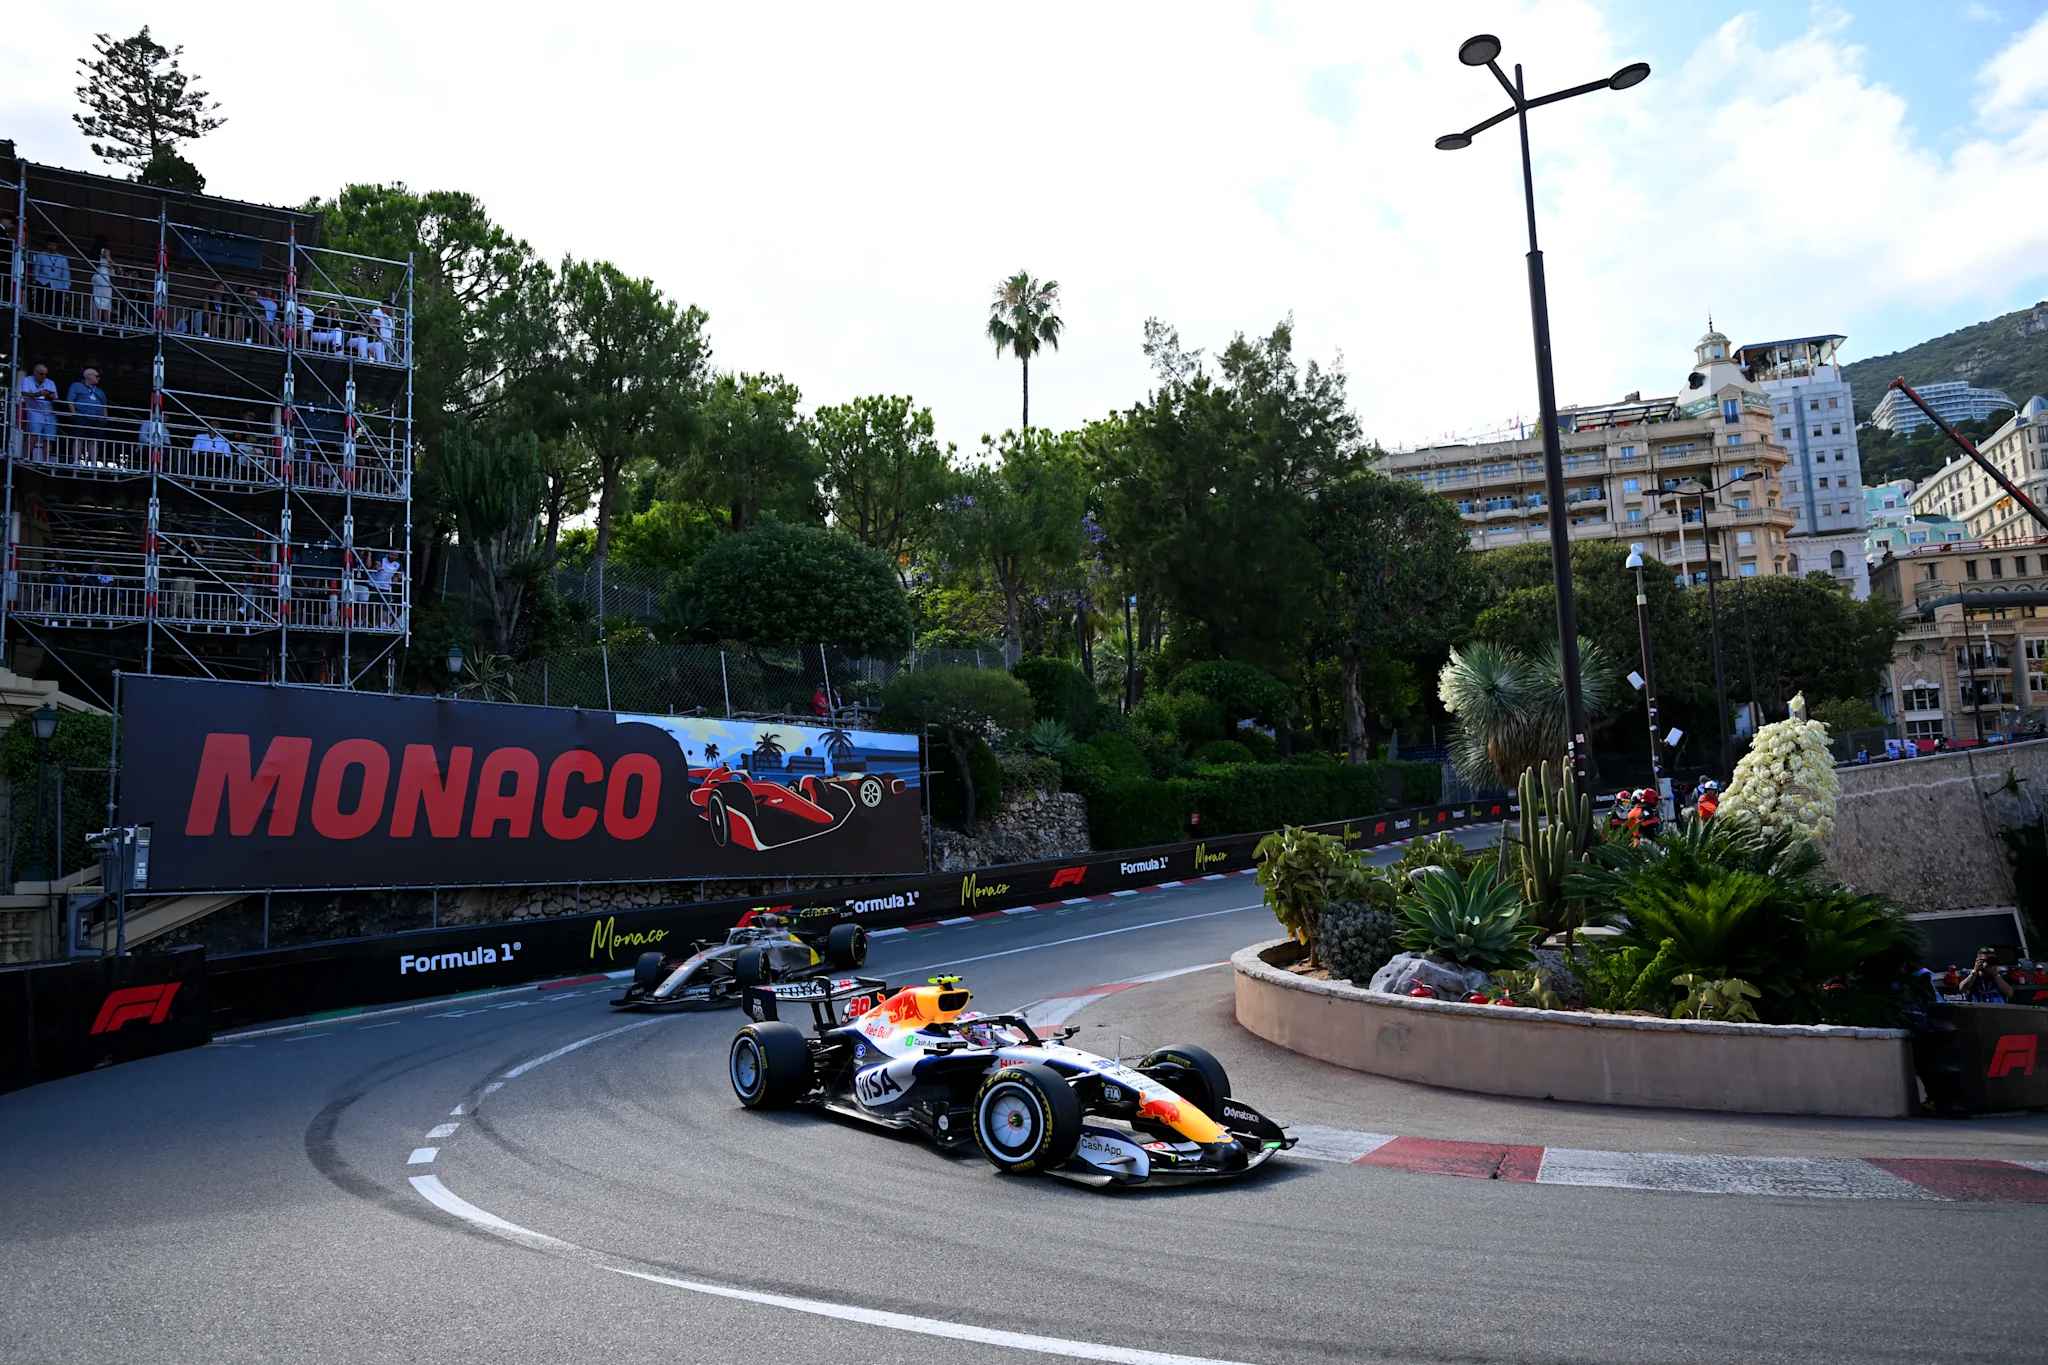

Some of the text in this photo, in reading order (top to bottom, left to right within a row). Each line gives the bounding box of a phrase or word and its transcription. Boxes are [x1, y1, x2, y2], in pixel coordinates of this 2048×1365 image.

[186, 733, 662, 841] MONACO
[1120, 859, 1160, 875] Formula
[1195, 843, 1227, 871] Monaco
[962, 872, 1011, 908] Monaco
[590, 916, 670, 961] Monaco
[400, 946, 497, 975] Formula
[850, 996, 870, 1017] 30
[864, 1022, 894, 1039] Red Bull
[858, 1067, 903, 1101] VISA
[1105, 1084, 1120, 1098] FIA
[1229, 1107, 1260, 1123] dynatrace
[1081, 1138, 1122, 1156] Cash App
